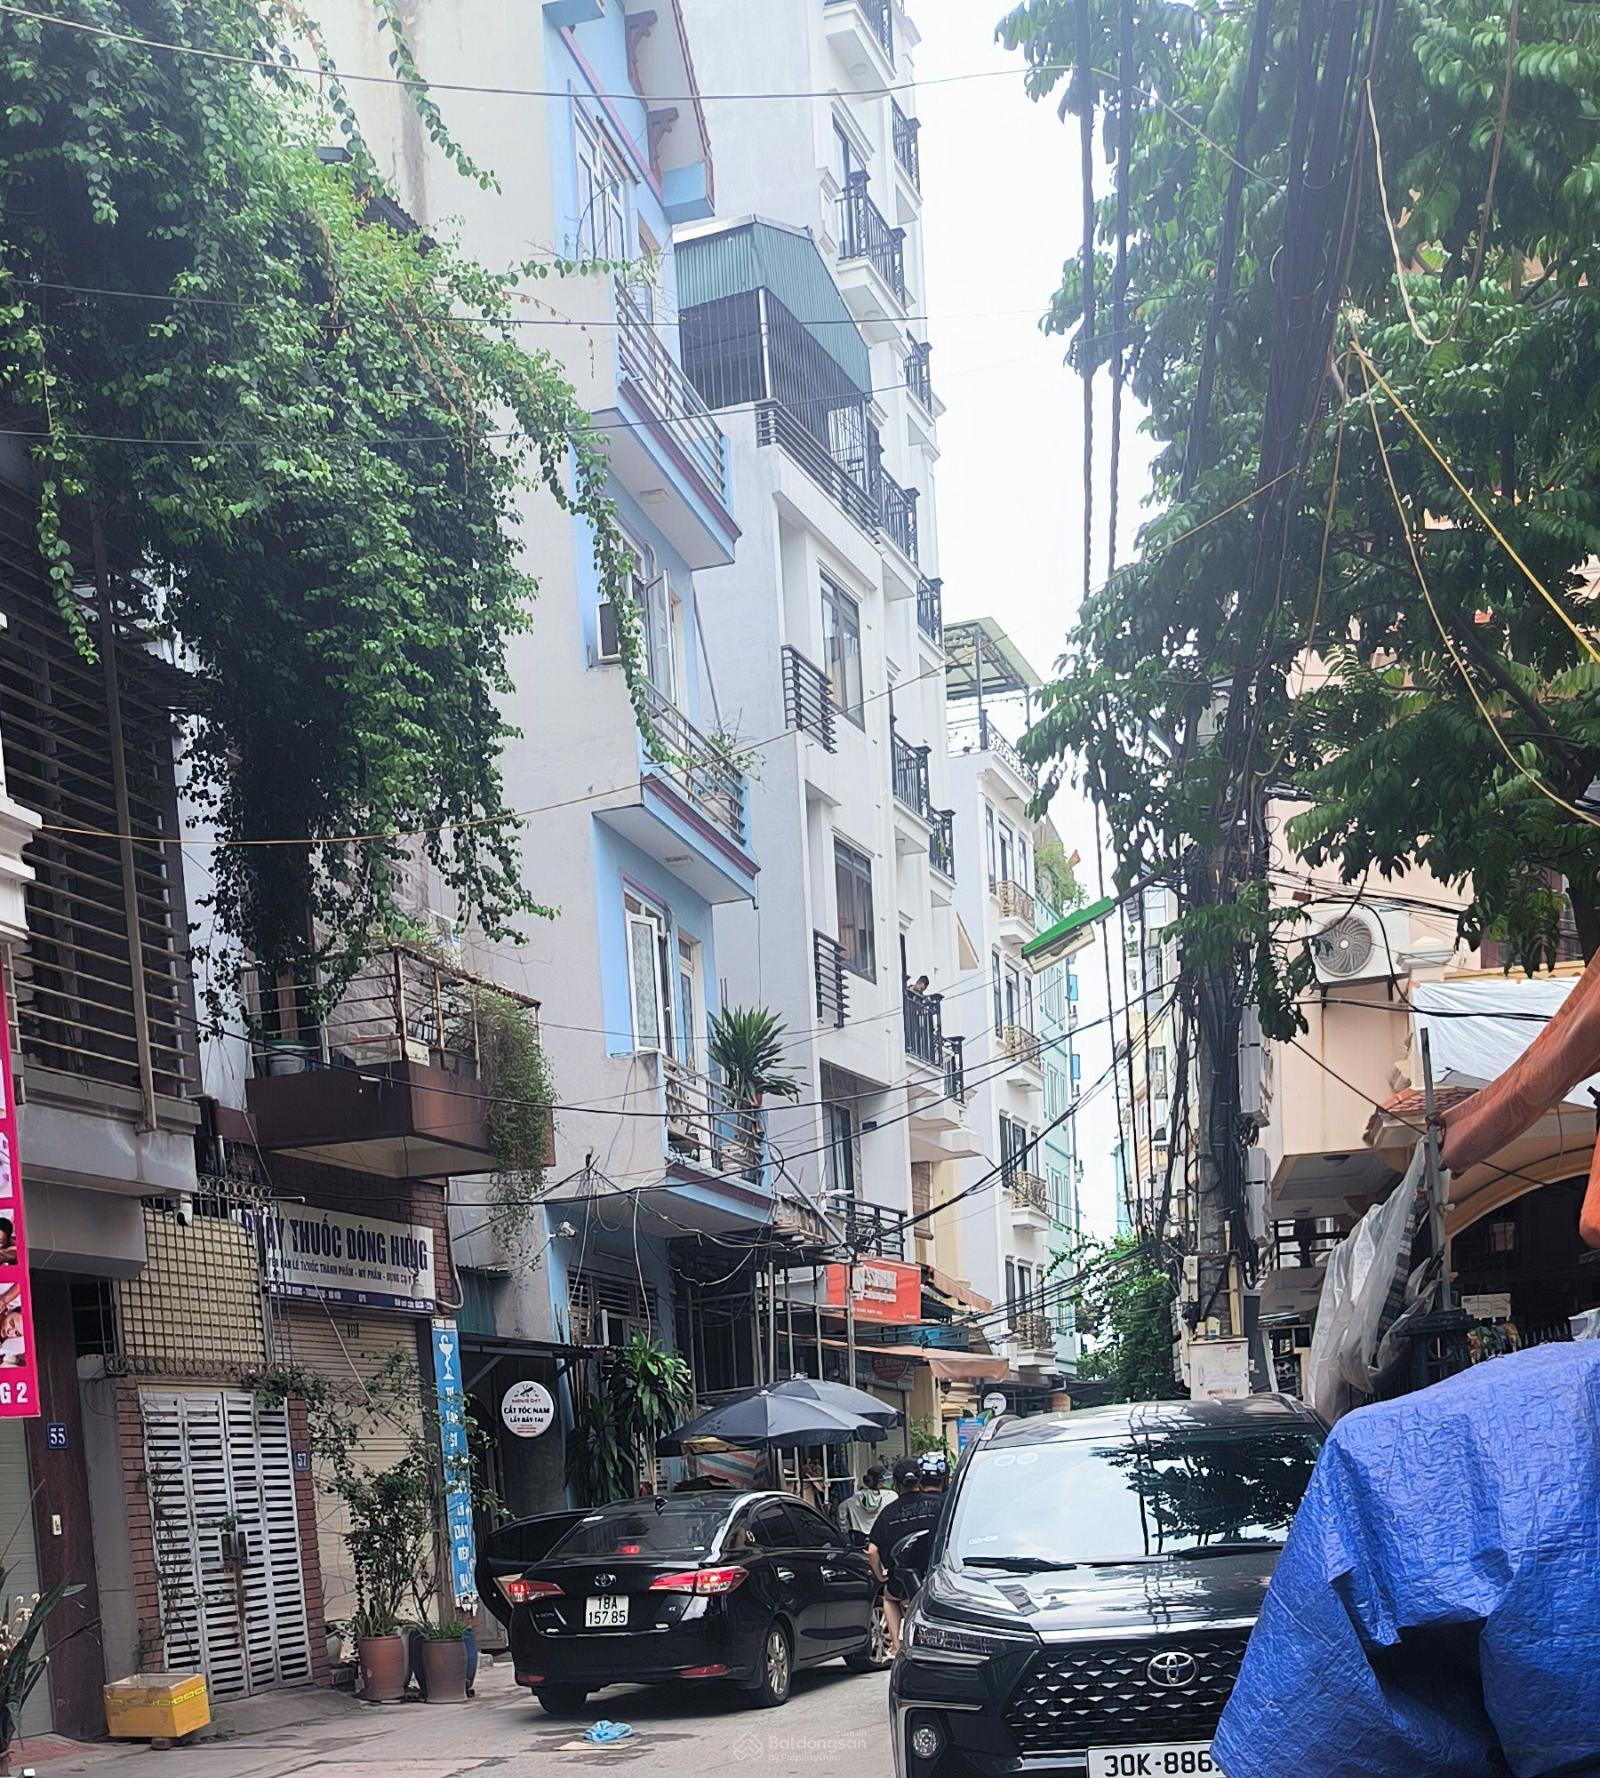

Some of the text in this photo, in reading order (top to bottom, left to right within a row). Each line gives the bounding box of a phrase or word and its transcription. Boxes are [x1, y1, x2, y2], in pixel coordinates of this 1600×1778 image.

[289, 1213, 342, 1258] THUỐC
[390, 1233, 428, 1271] HƯNG
[16, 1382, 28, 1403] 2
[50, 1427, 66, 1445] 55
[297, 1453, 307, 1467] 57
[598, 1597, 618, 1610] 18A
[588, 1611, 626, 1625] 157.85
[1103, 1751, 1221, 1777] 30K-886.
